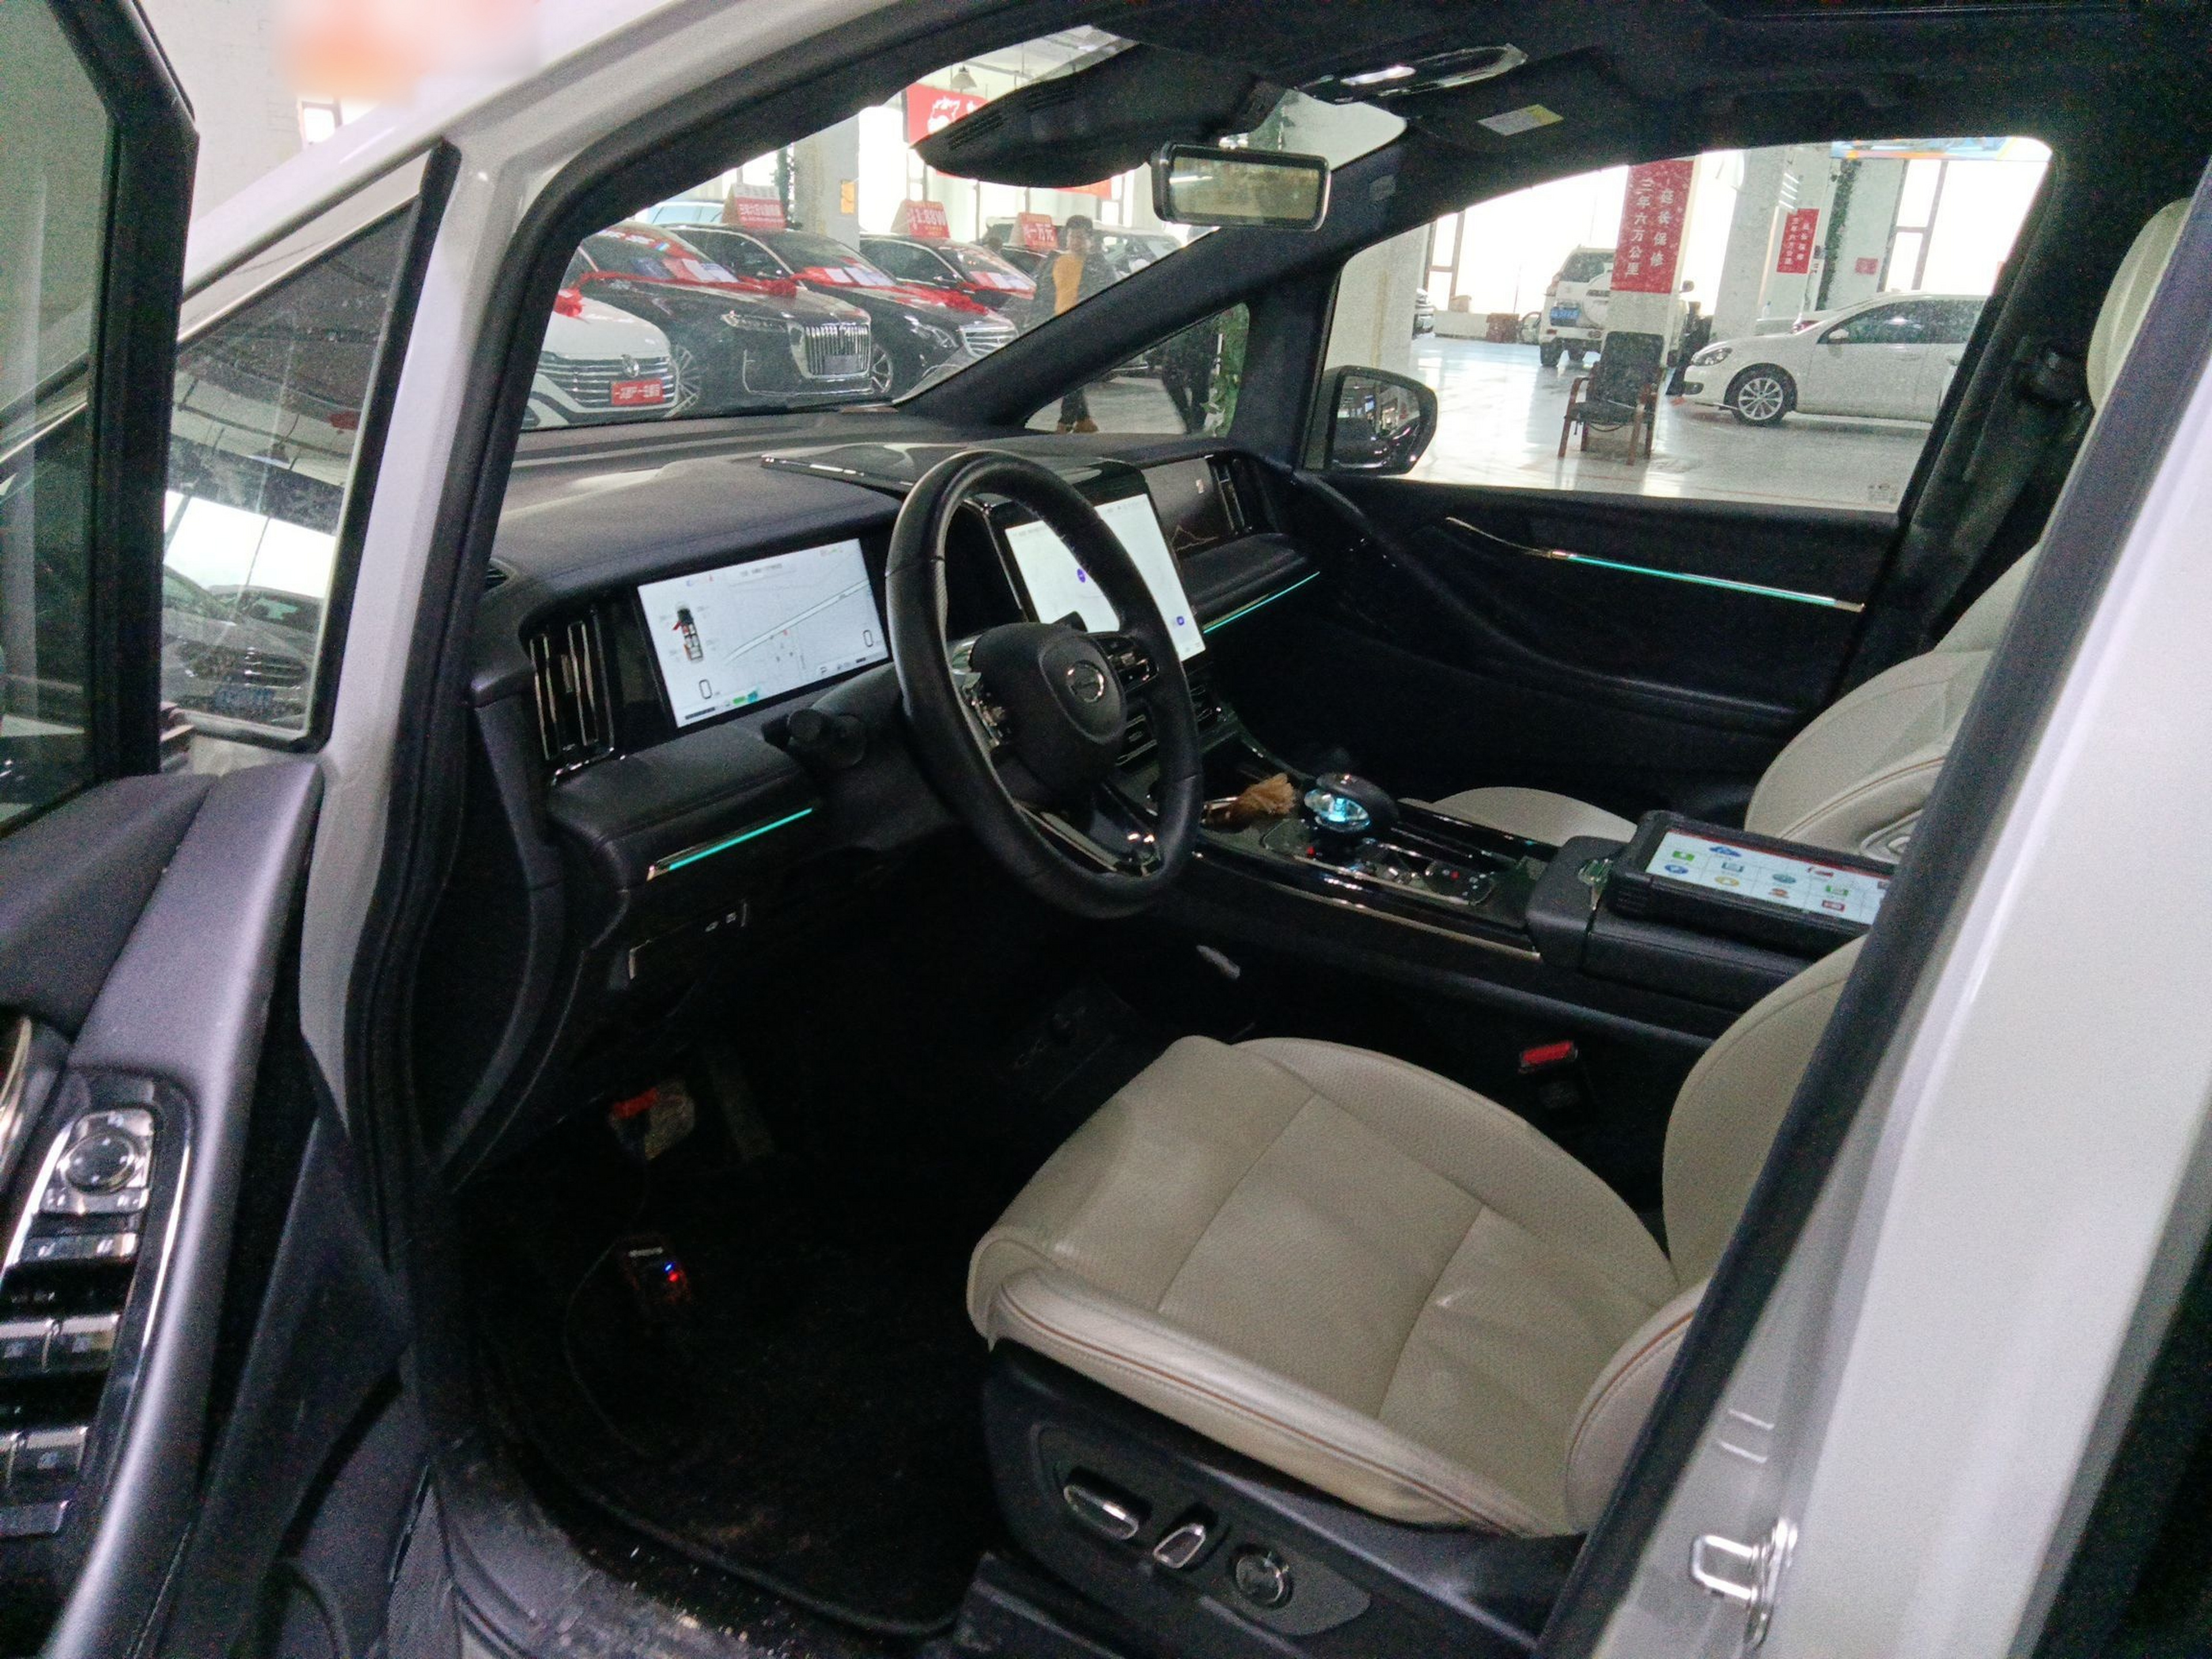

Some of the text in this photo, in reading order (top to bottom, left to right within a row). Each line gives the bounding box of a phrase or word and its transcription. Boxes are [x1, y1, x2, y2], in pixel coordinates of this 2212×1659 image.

[1625, 177, 1655, 277] 三年六万公里
